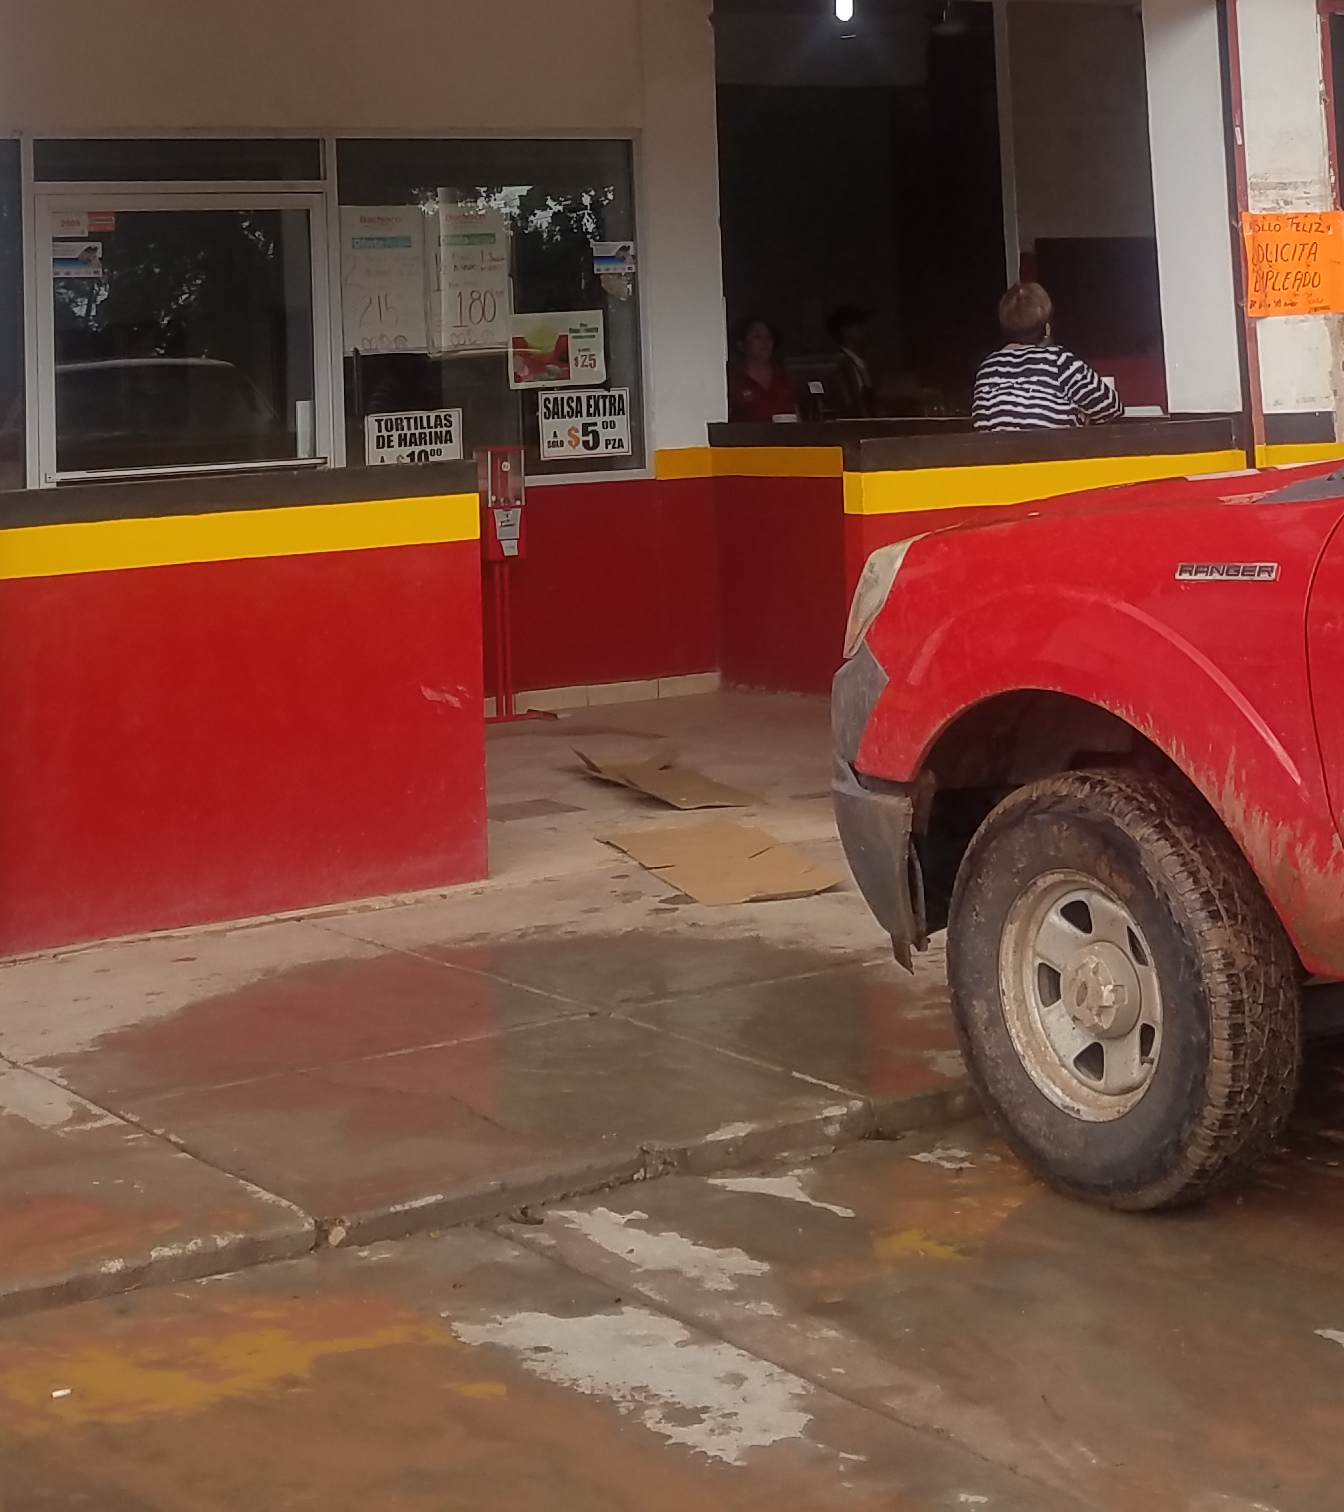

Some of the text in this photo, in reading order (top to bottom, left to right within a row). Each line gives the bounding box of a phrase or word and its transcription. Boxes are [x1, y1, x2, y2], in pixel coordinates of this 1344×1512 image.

[1251, 222, 1282, 234] OLLO
[452, 289, 497, 329] 180
[573, 353, 597, 369] $25
[543, 393, 626, 420] SALSA EXTRA
[374, 413, 454, 434] TORTILLAS
[375, 430, 454, 450] DE HARINA
[552, 430, 559, 439] A
[547, 439, 565, 449] SOLO
[604, 437, 625, 450] PZA
[379, 455, 386, 464] A
[1177, 563, 1276, 578] RANGER
